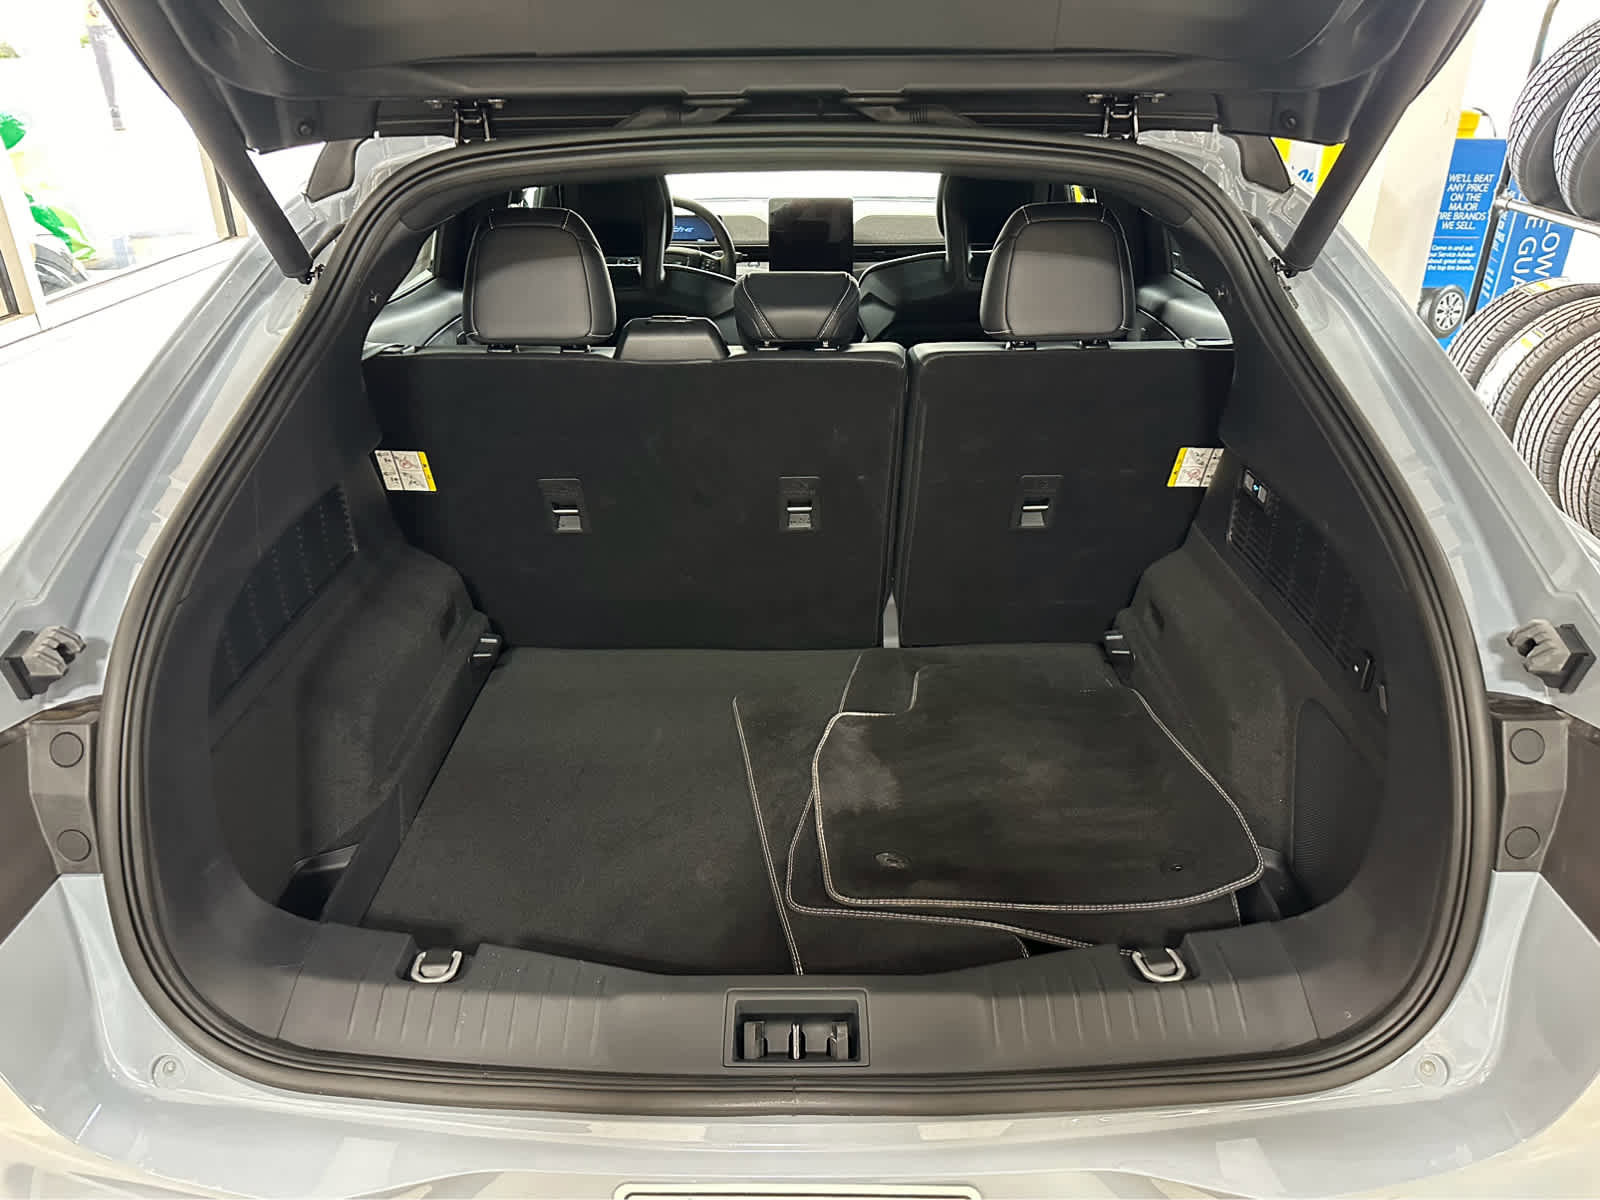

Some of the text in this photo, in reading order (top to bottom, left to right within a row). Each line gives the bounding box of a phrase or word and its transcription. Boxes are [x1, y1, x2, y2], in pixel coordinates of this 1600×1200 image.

[1473, 173, 1495, 182] BEAT
[1447, 183, 1489, 192] ANY PRICE
[1450, 193, 1482, 202] ON THE
[1448, 202, 1478, 211] MAJOR
[1453, 211, 1487, 221] BRANDS
[1442, 221, 1455, 230] WE
